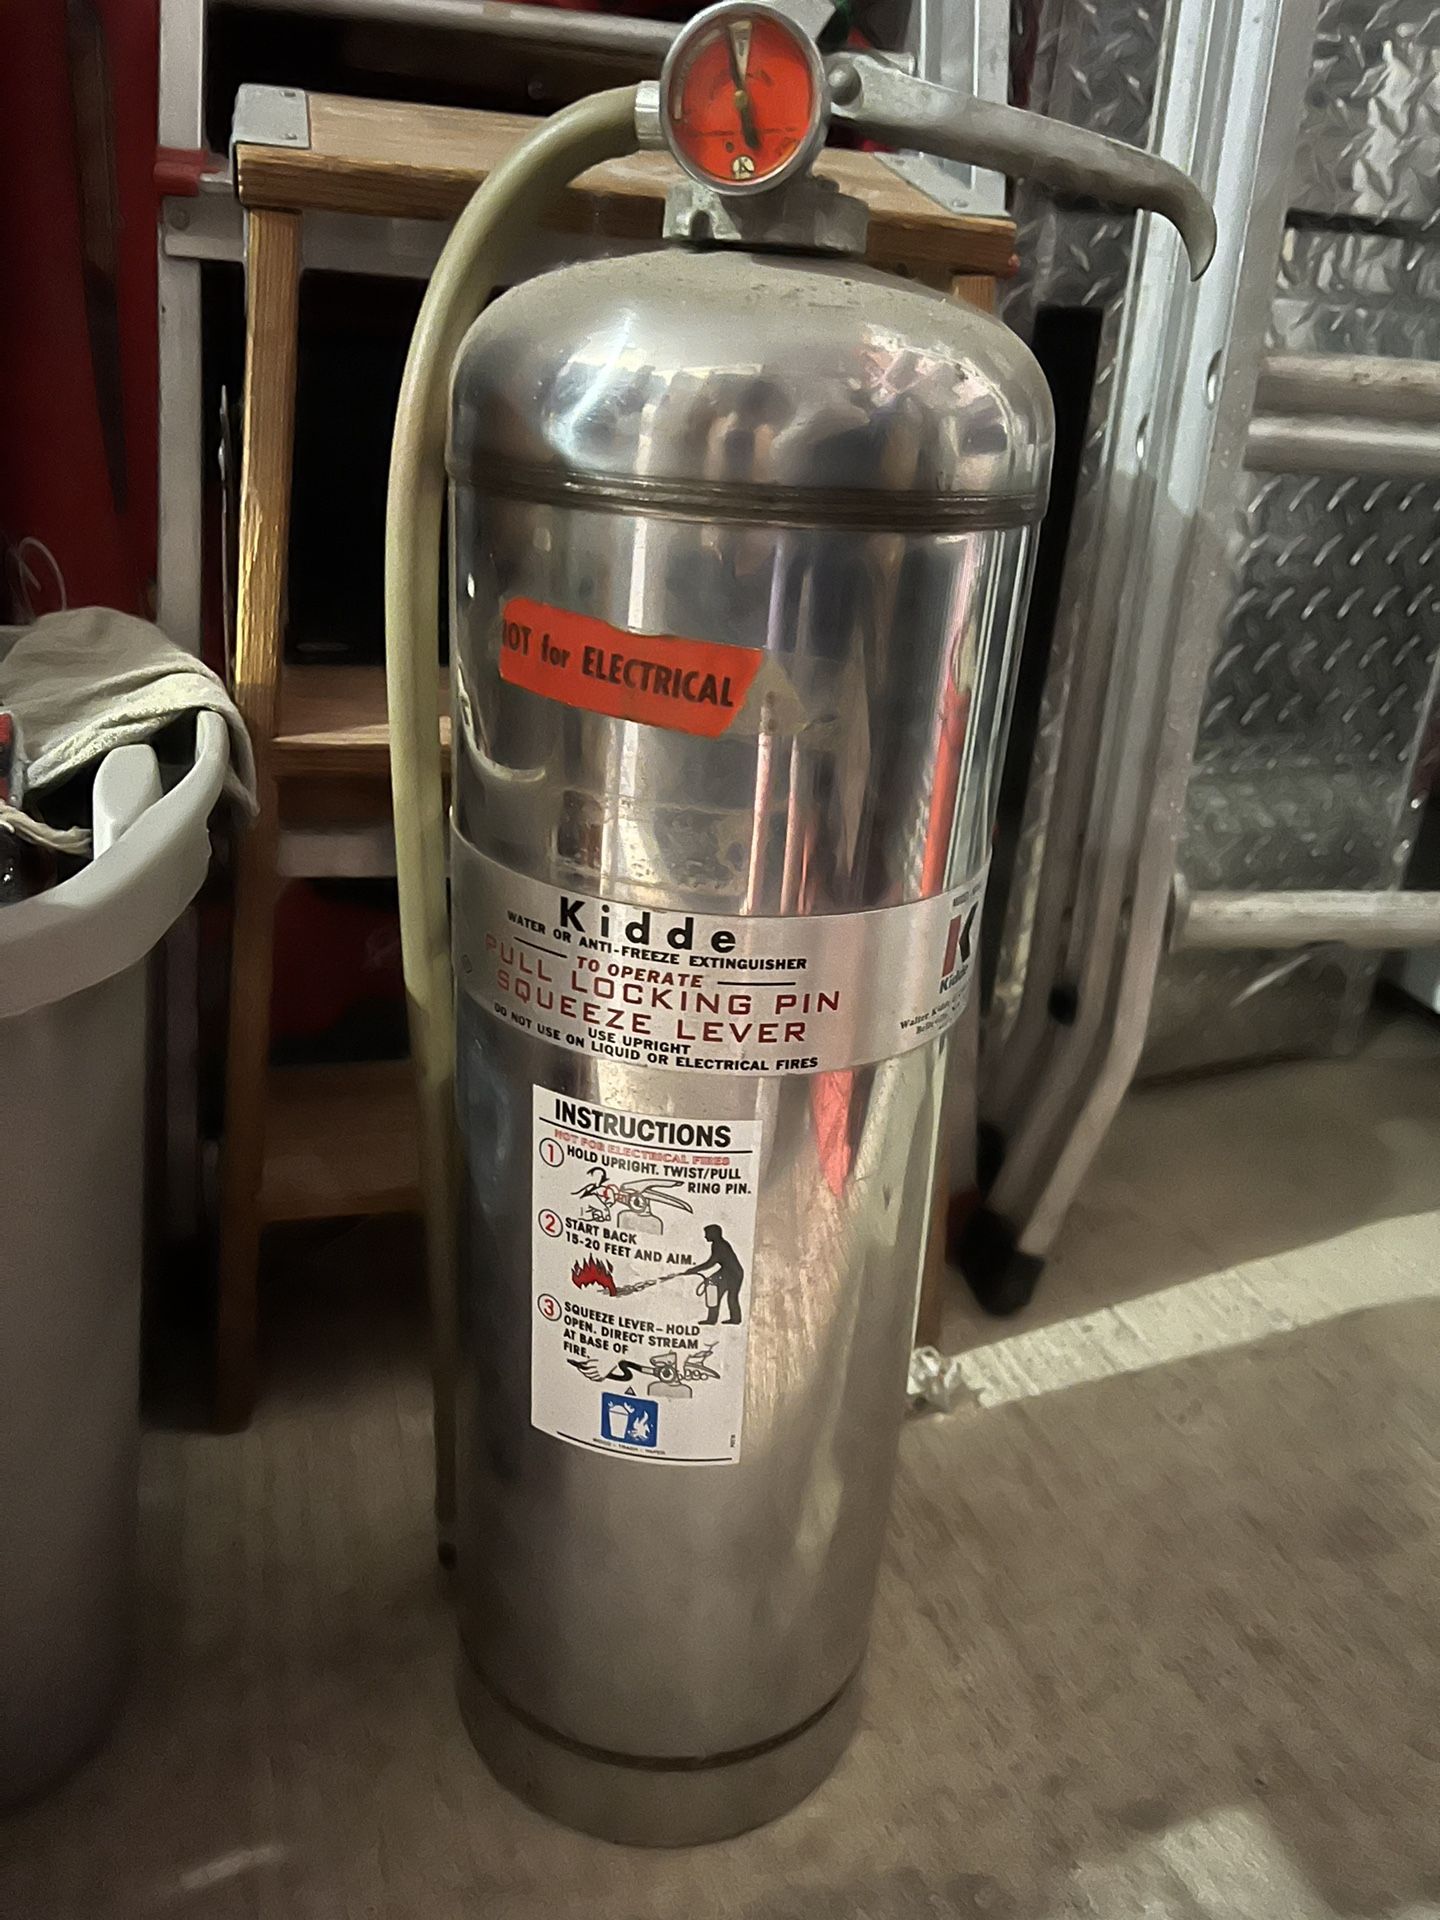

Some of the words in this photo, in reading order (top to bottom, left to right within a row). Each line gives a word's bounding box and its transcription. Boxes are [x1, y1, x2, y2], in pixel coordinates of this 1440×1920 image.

[541, 633, 570, 668] for
[582, 645, 734, 707] ELECTRICAL
[507, 910, 546, 935] WATER
[553, 928, 571, 943] OR
[579, 936, 680, 965] ANTI-FREEZE
[689, 955, 807, 970] EXTINGUISHER
[560, 896, 736, 953] Kidde
[485, 932, 552, 983] PULL
[571, 970, 752, 1015] LOCKING
[775, 990, 840, 1015] PIN
[577, 955, 600, 973] TO
[607, 963, 704, 989] OPERATE
[496, 969, 652, 1035] SQUEEZE
[676, 1019, 806, 1043] LEVER
[494, 1002, 507, 1017] DO
[511, 1012, 533, 1029] NOT
[537, 1023, 561, 1041] USE
[566, 1033, 585, 1048] ON
[591, 1041, 640, 1060] LIQUID
[647, 1053, 668, 1065] OR
[676, 1056, 769, 1071] ELECTRICAL
[776, 1057, 819, 1071] FIRES
[588, 1027, 616, 1043] USE
[622, 1035, 691, 1055] UPRIGHT
[555, 1098, 732, 1148] INSTRUCTIONS
[547, 1144, 555, 1163] 1
[567, 1145, 598, 1163] HOLD
[601, 1156, 660, 1176] UPRIGHT.
[664, 1165, 741, 1180] TWIST/PULL
[688, 1182, 721, 1194] RING
[725, 1184, 752, 1195] PIN.
[545, 1215, 556, 1233] 2
[565, 1217, 600, 1237] START
[603, 1225, 638, 1245] BACK
[566, 1231, 600, 1251] 15-20
[604, 1243, 631, 1258] FEET
[634, 1249, 662, 1263] AND
[666, 1253, 697, 1266] AIM.
[543, 1298, 555, 1317] 3
[564, 1301, 615, 1325] SQUEEZE
[563, 1329, 576, 1341] AT
[579, 1334, 609, 1351] BASE
[613, 1343, 629, 1355] OF
[564, 1316, 597, 1335] OPEN.
[601, 1328, 644, 1345] DIRECT
[648, 1336, 699, 1350] STREAM
[564, 1341, 590, 1359] FIRE.
